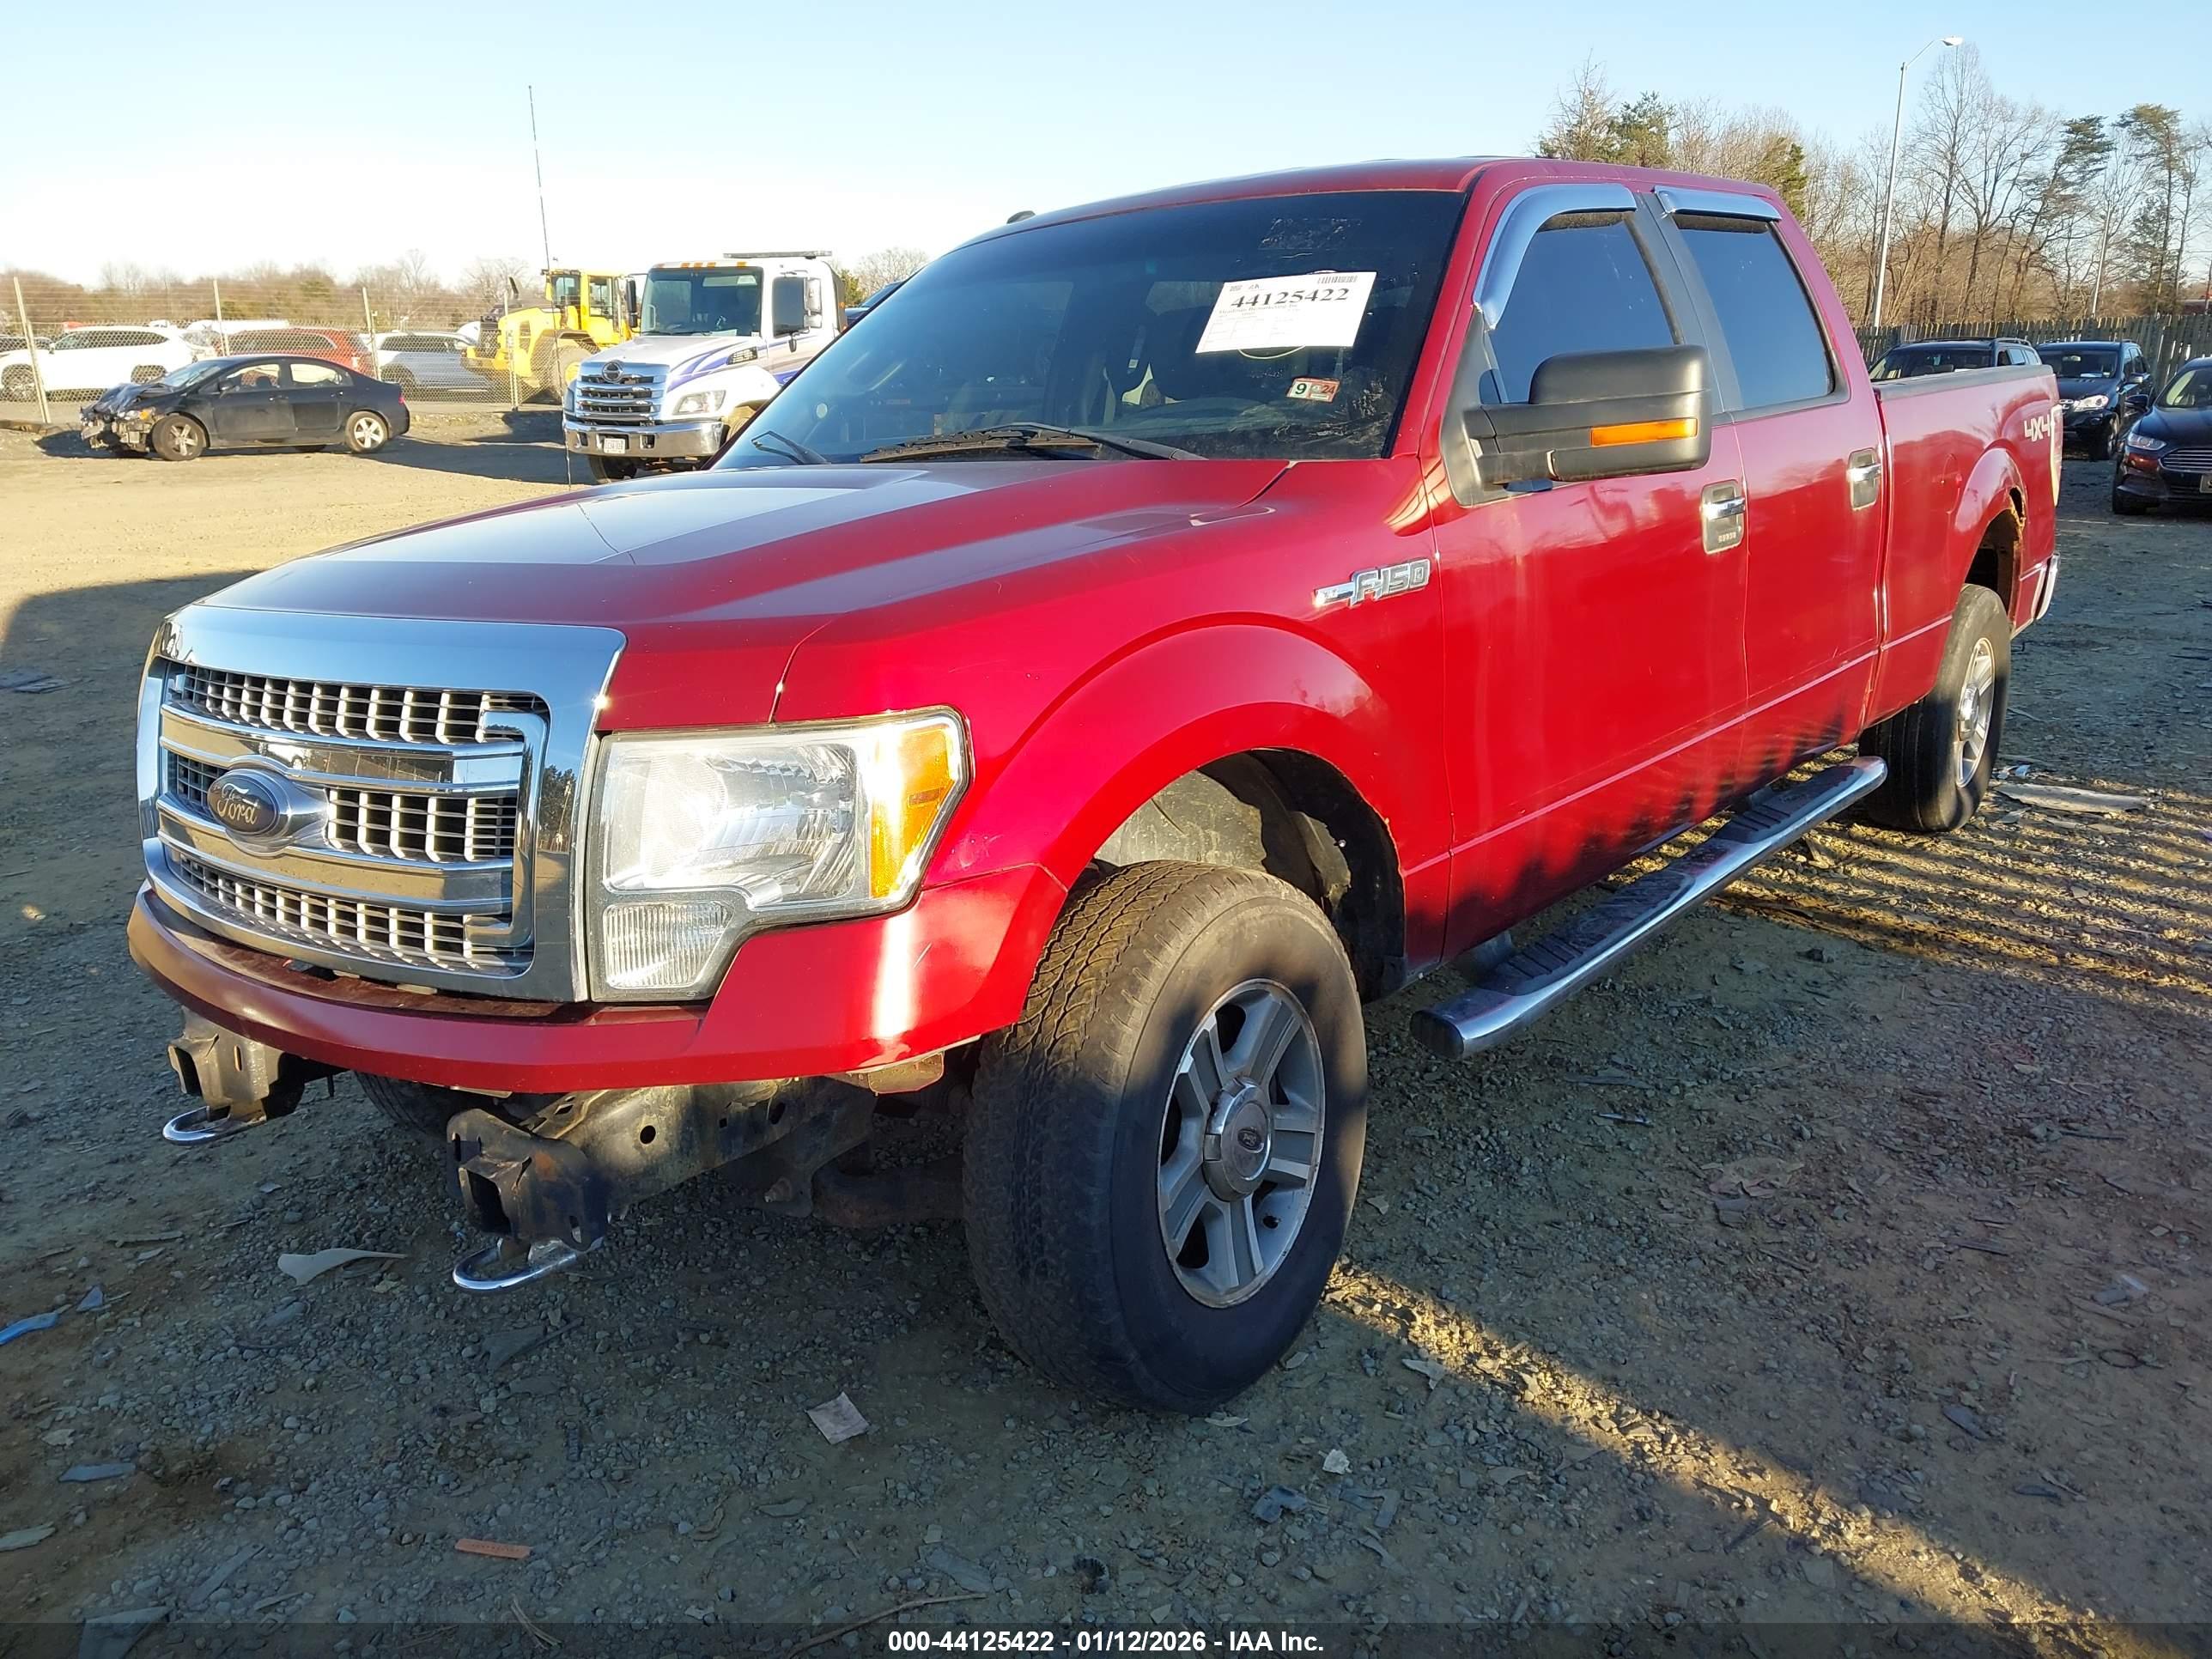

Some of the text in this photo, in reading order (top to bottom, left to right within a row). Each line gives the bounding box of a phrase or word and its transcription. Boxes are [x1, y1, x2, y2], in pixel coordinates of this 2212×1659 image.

[1231, 288, 1349, 308] 44125422
[1295, 383, 1307, 395] 9
[216, 782, 261, 825] Ford
